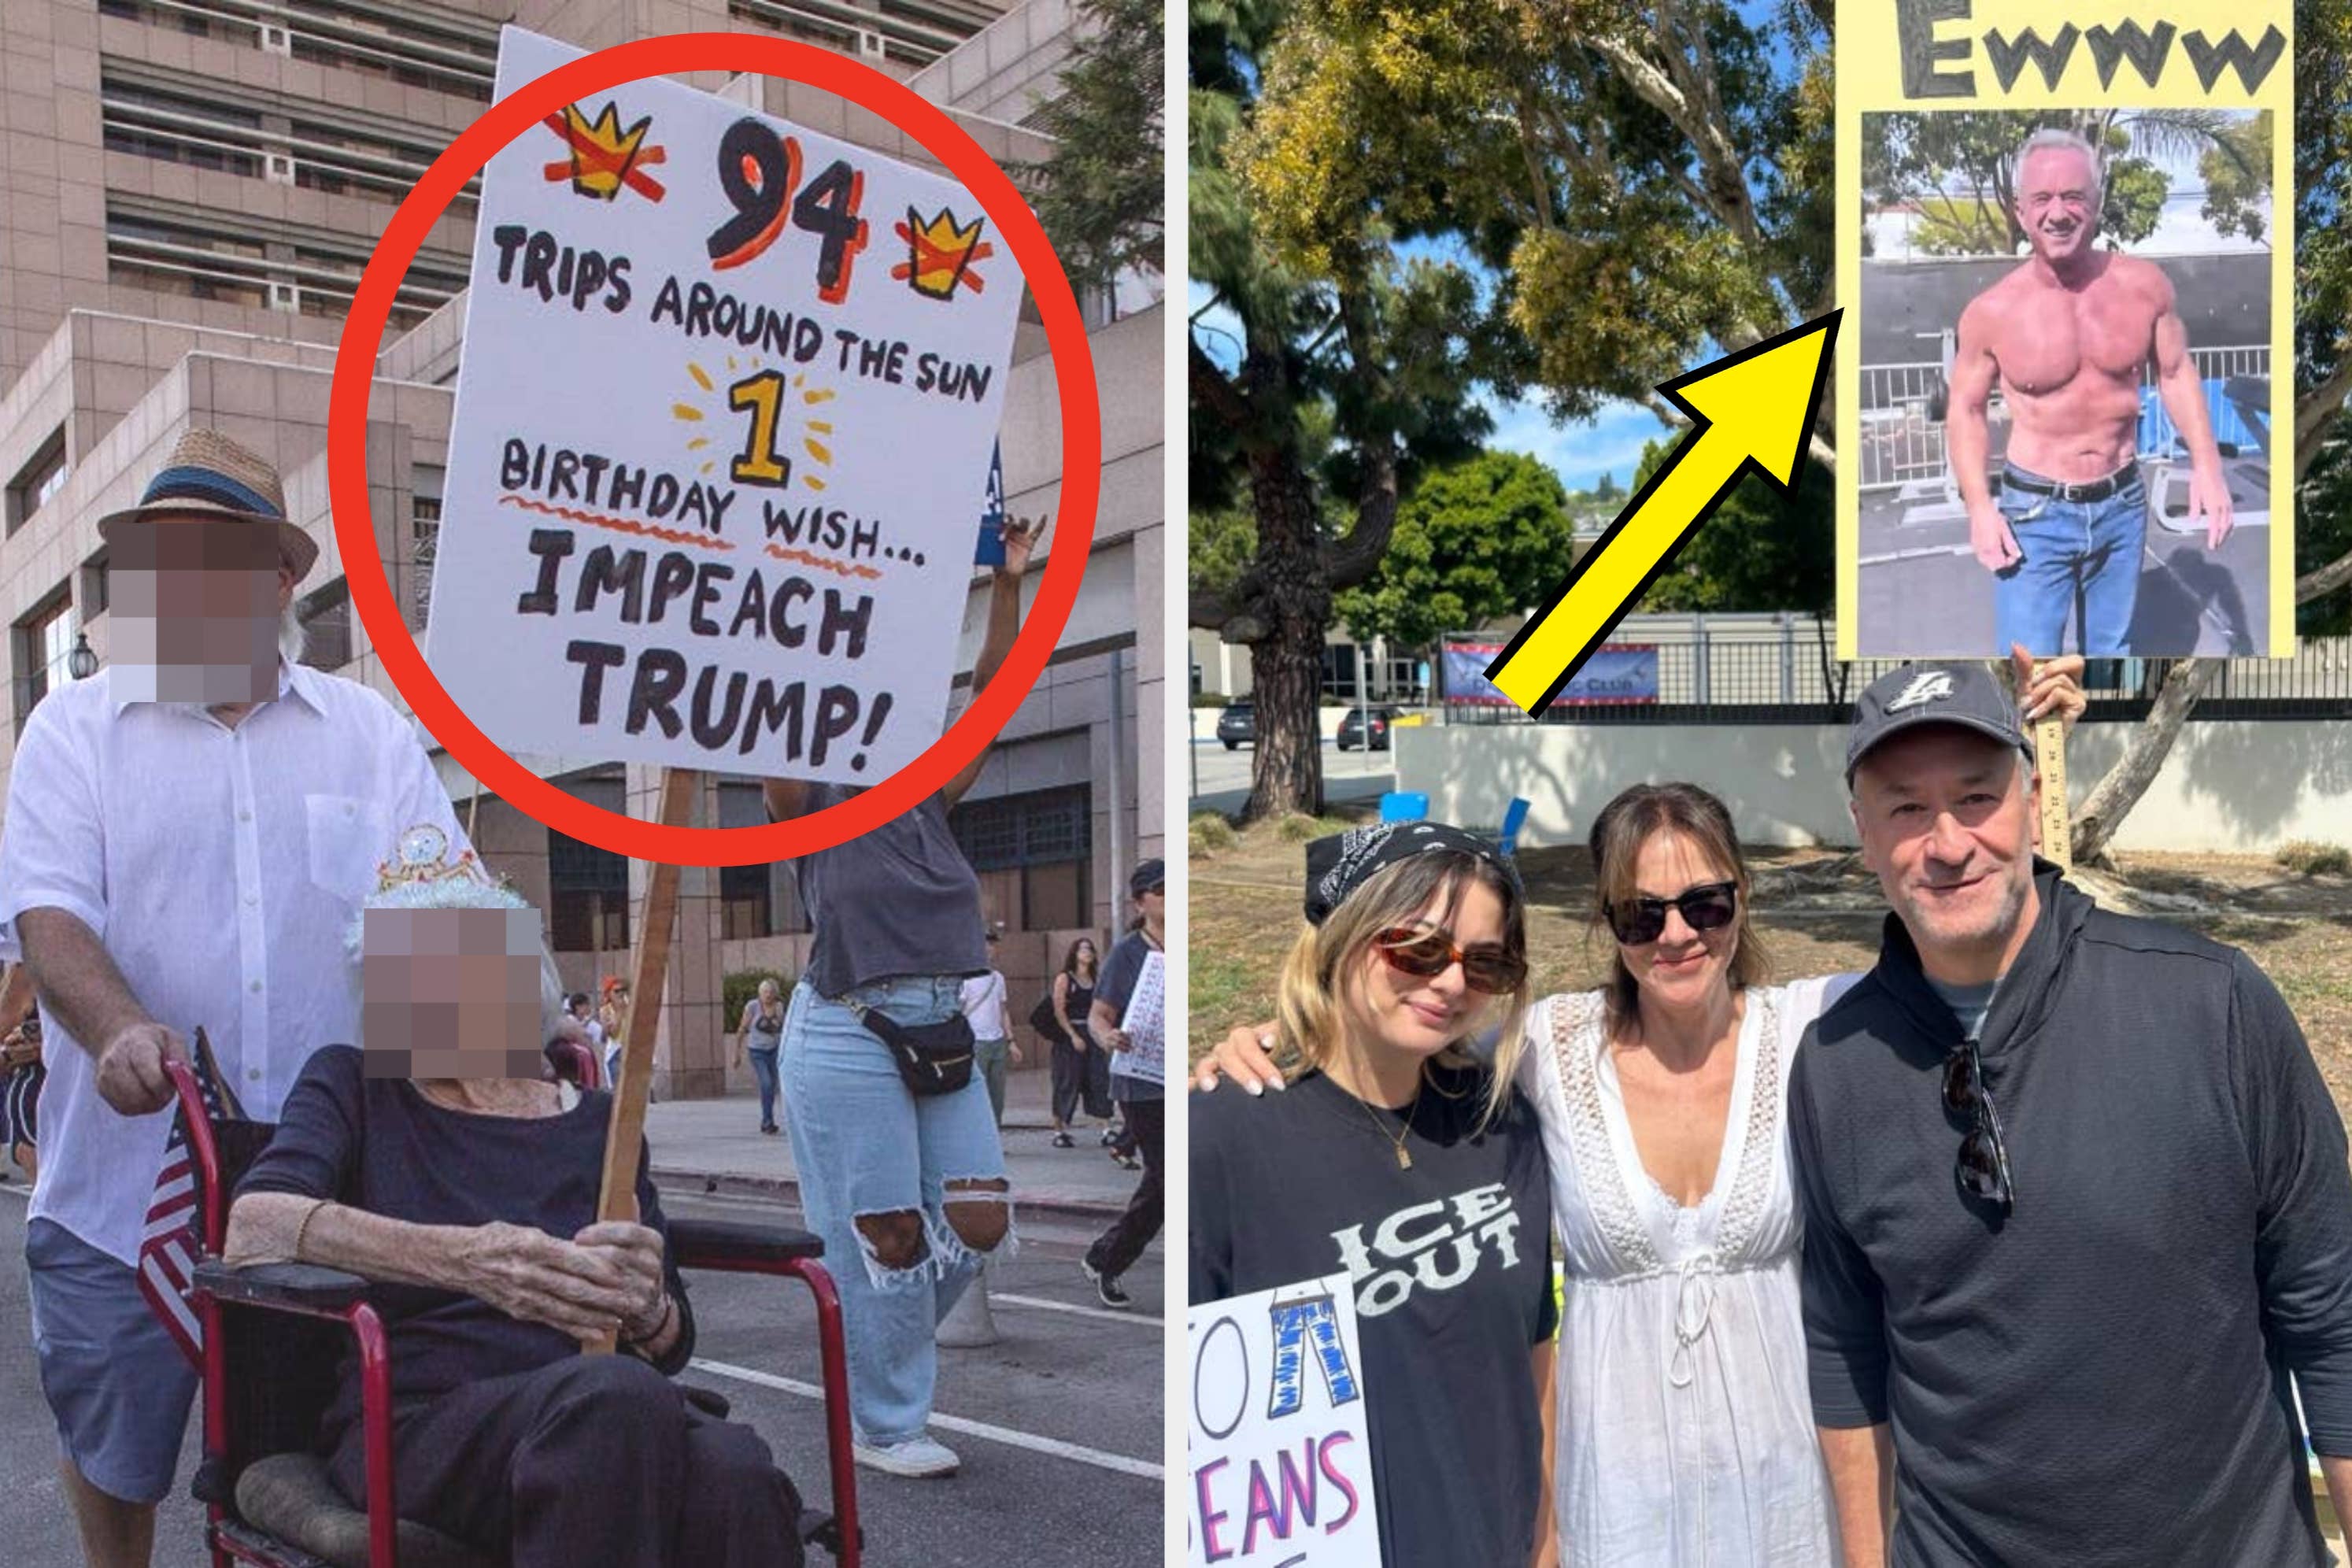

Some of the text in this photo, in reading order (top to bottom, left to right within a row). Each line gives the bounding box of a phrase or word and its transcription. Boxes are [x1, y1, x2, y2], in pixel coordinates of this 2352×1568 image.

[707, 117, 869, 305] 94
[494, 225, 992, 403] TRIPS AROUND THE SUN
[728, 368, 791, 488] 1
[500, 438, 925, 568] BIRTHDAY WISH...
[517, 528, 874, 659] IMPEACH
[566, 640, 893, 773] TRUMP!
[1330, 1182, 1511, 1284] ICE
[1355, 1211, 1520, 1317] OUT
[1189, 1315, 1250, 1440] O
[1189, 1429, 1359, 1563] EANS
